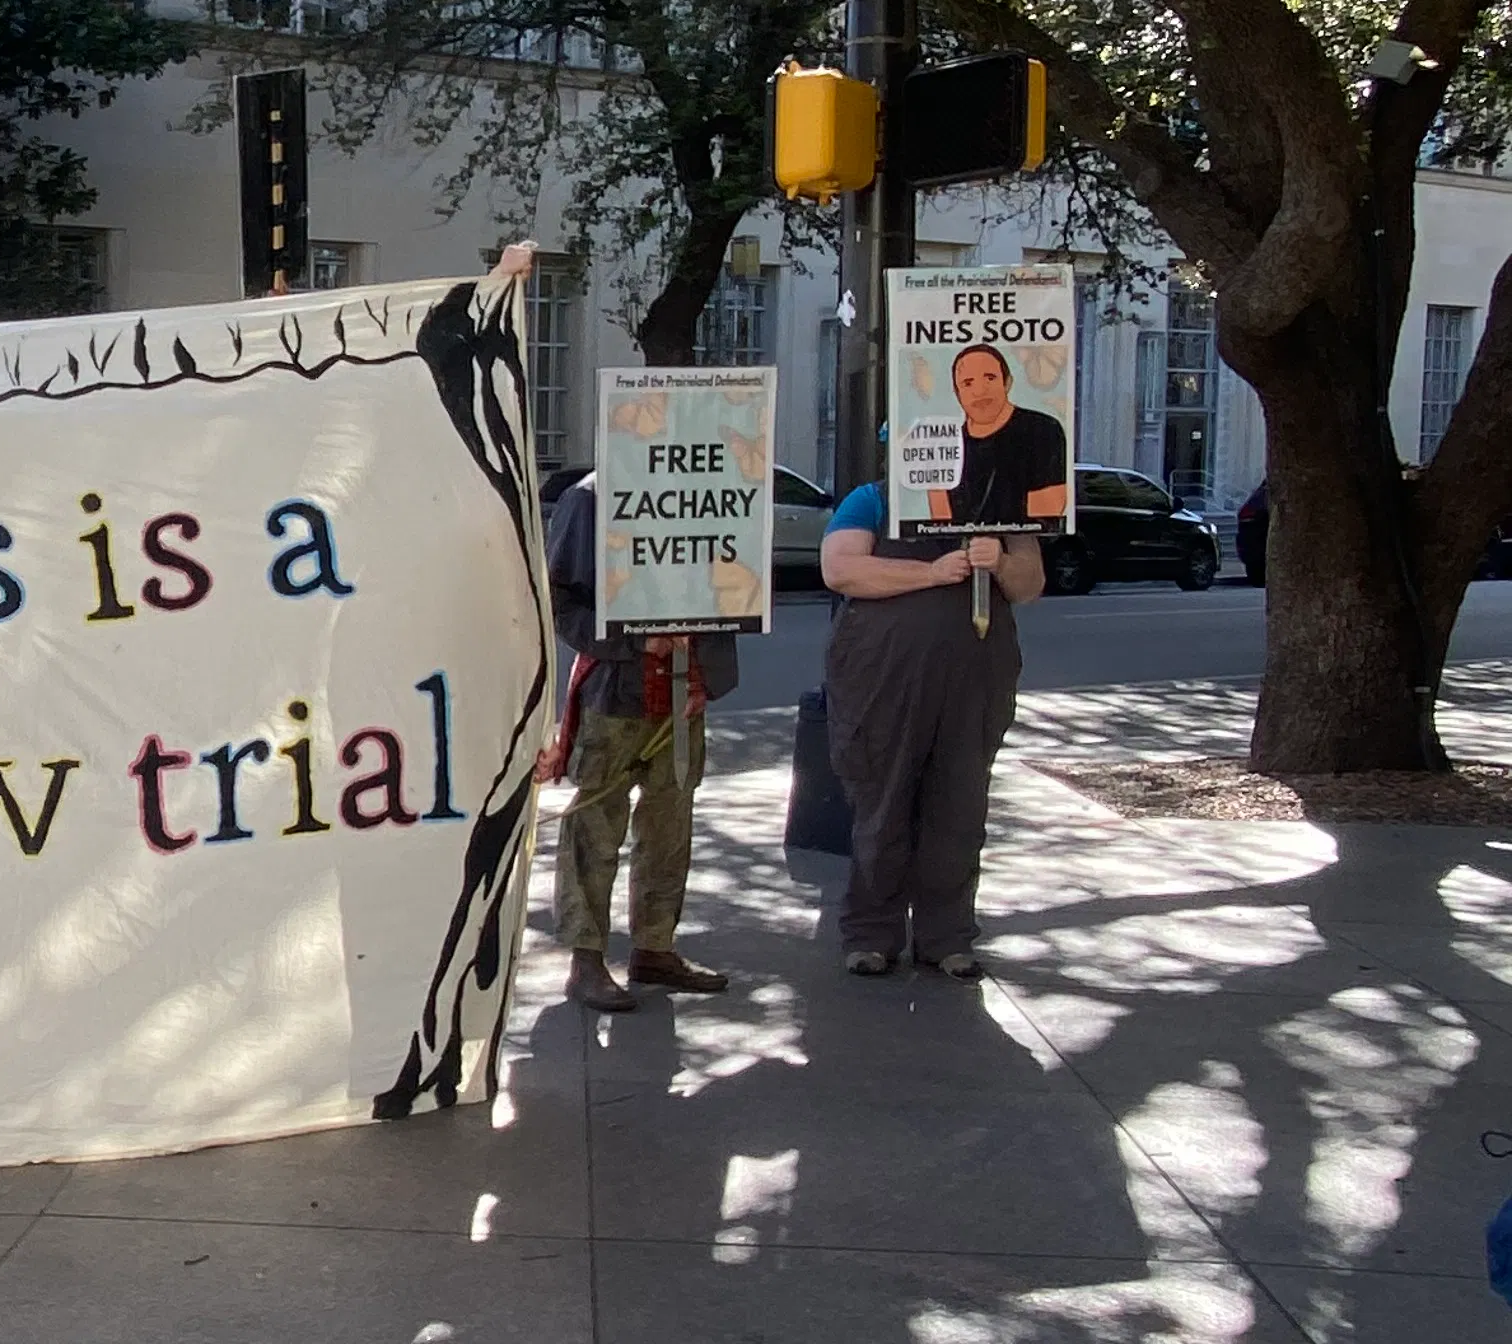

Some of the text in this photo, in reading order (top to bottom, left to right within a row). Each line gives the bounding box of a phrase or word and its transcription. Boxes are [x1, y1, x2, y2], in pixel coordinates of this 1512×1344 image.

[953, 292, 1016, 314] FREE
[905, 318, 1065, 344] INES SOTO
[910, 424, 960, 439] ITTMAN:
[648, 443, 724, 474] FREE
[903, 446, 960, 462] OPEN THE
[909, 469, 955, 484] COURTS
[612, 488, 758, 521] ZACHARY
[81, 492, 213, 621] is
[264, 494, 353, 602] a
[632, 534, 737, 566] EVETTS
[129, 669, 468, 855] trial
